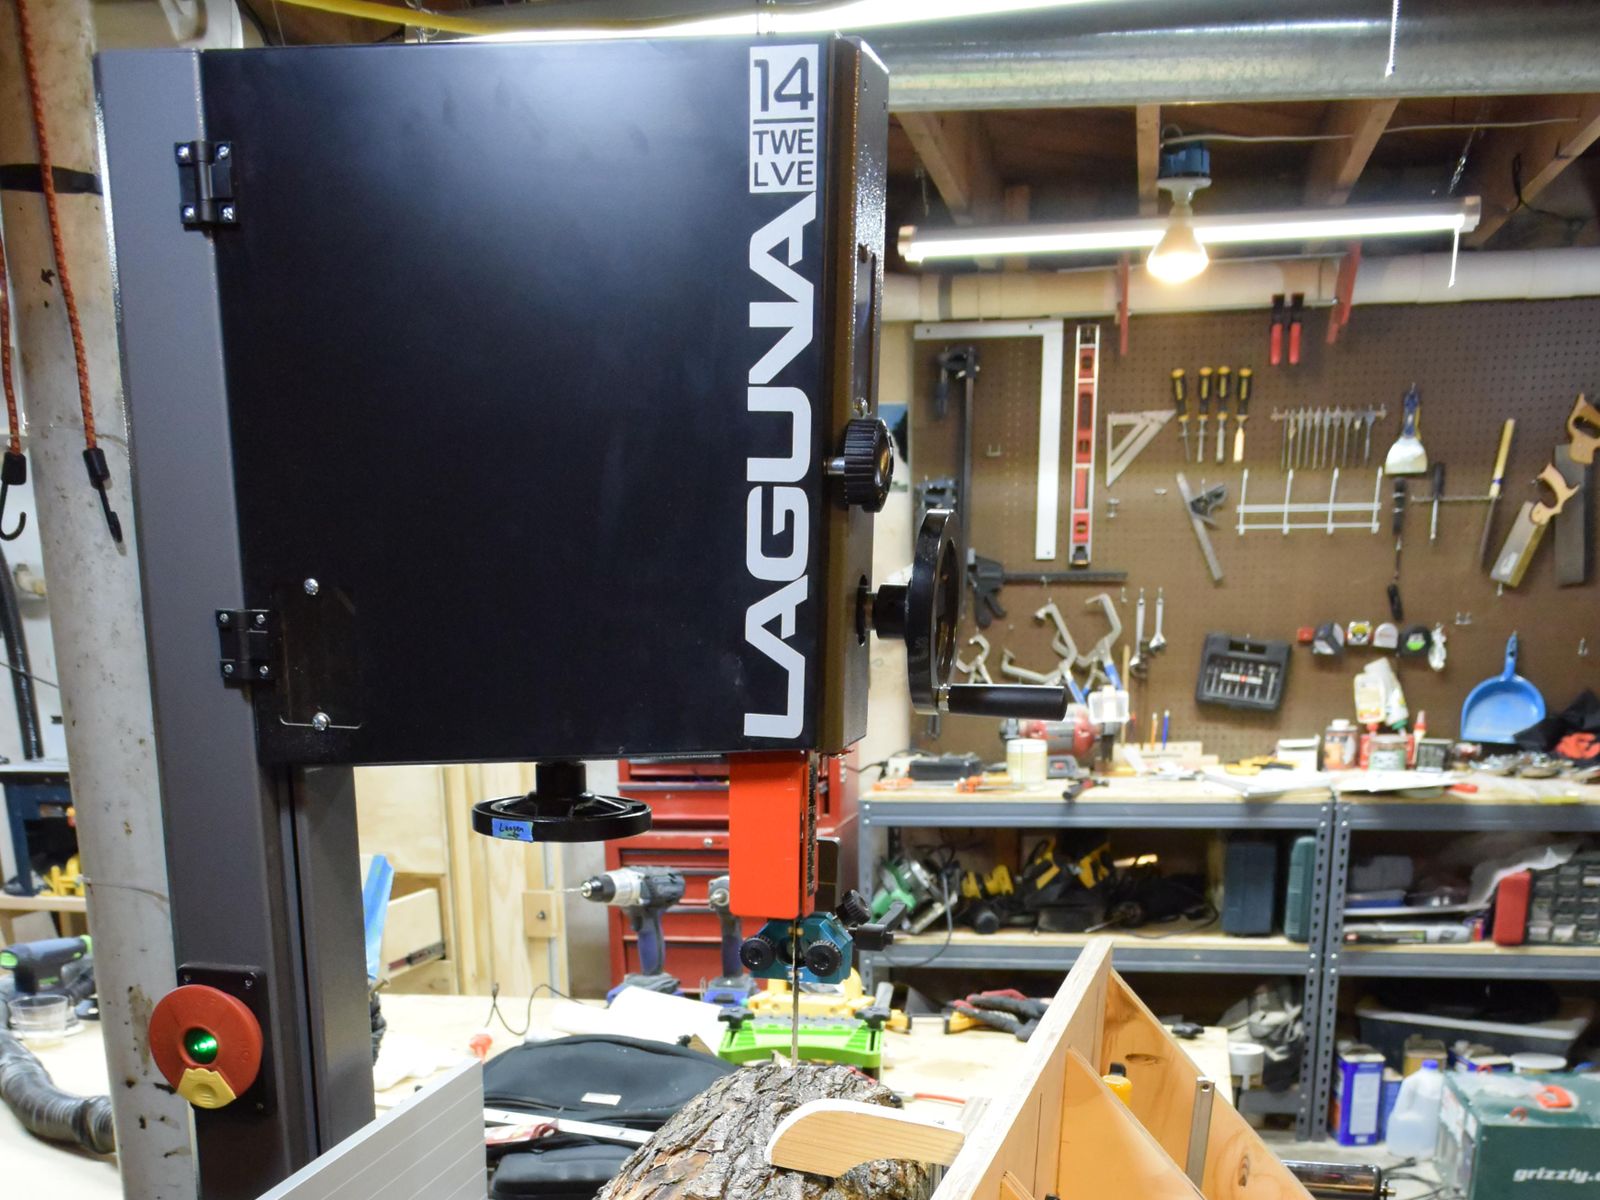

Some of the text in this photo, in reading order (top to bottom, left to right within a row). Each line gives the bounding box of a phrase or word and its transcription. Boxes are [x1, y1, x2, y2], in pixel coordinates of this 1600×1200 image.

[753, 57, 814, 112] 14
[752, 128, 814, 155] TWE
[753, 160, 814, 187] LVE
[743, 191, 817, 738] LAGUNA
